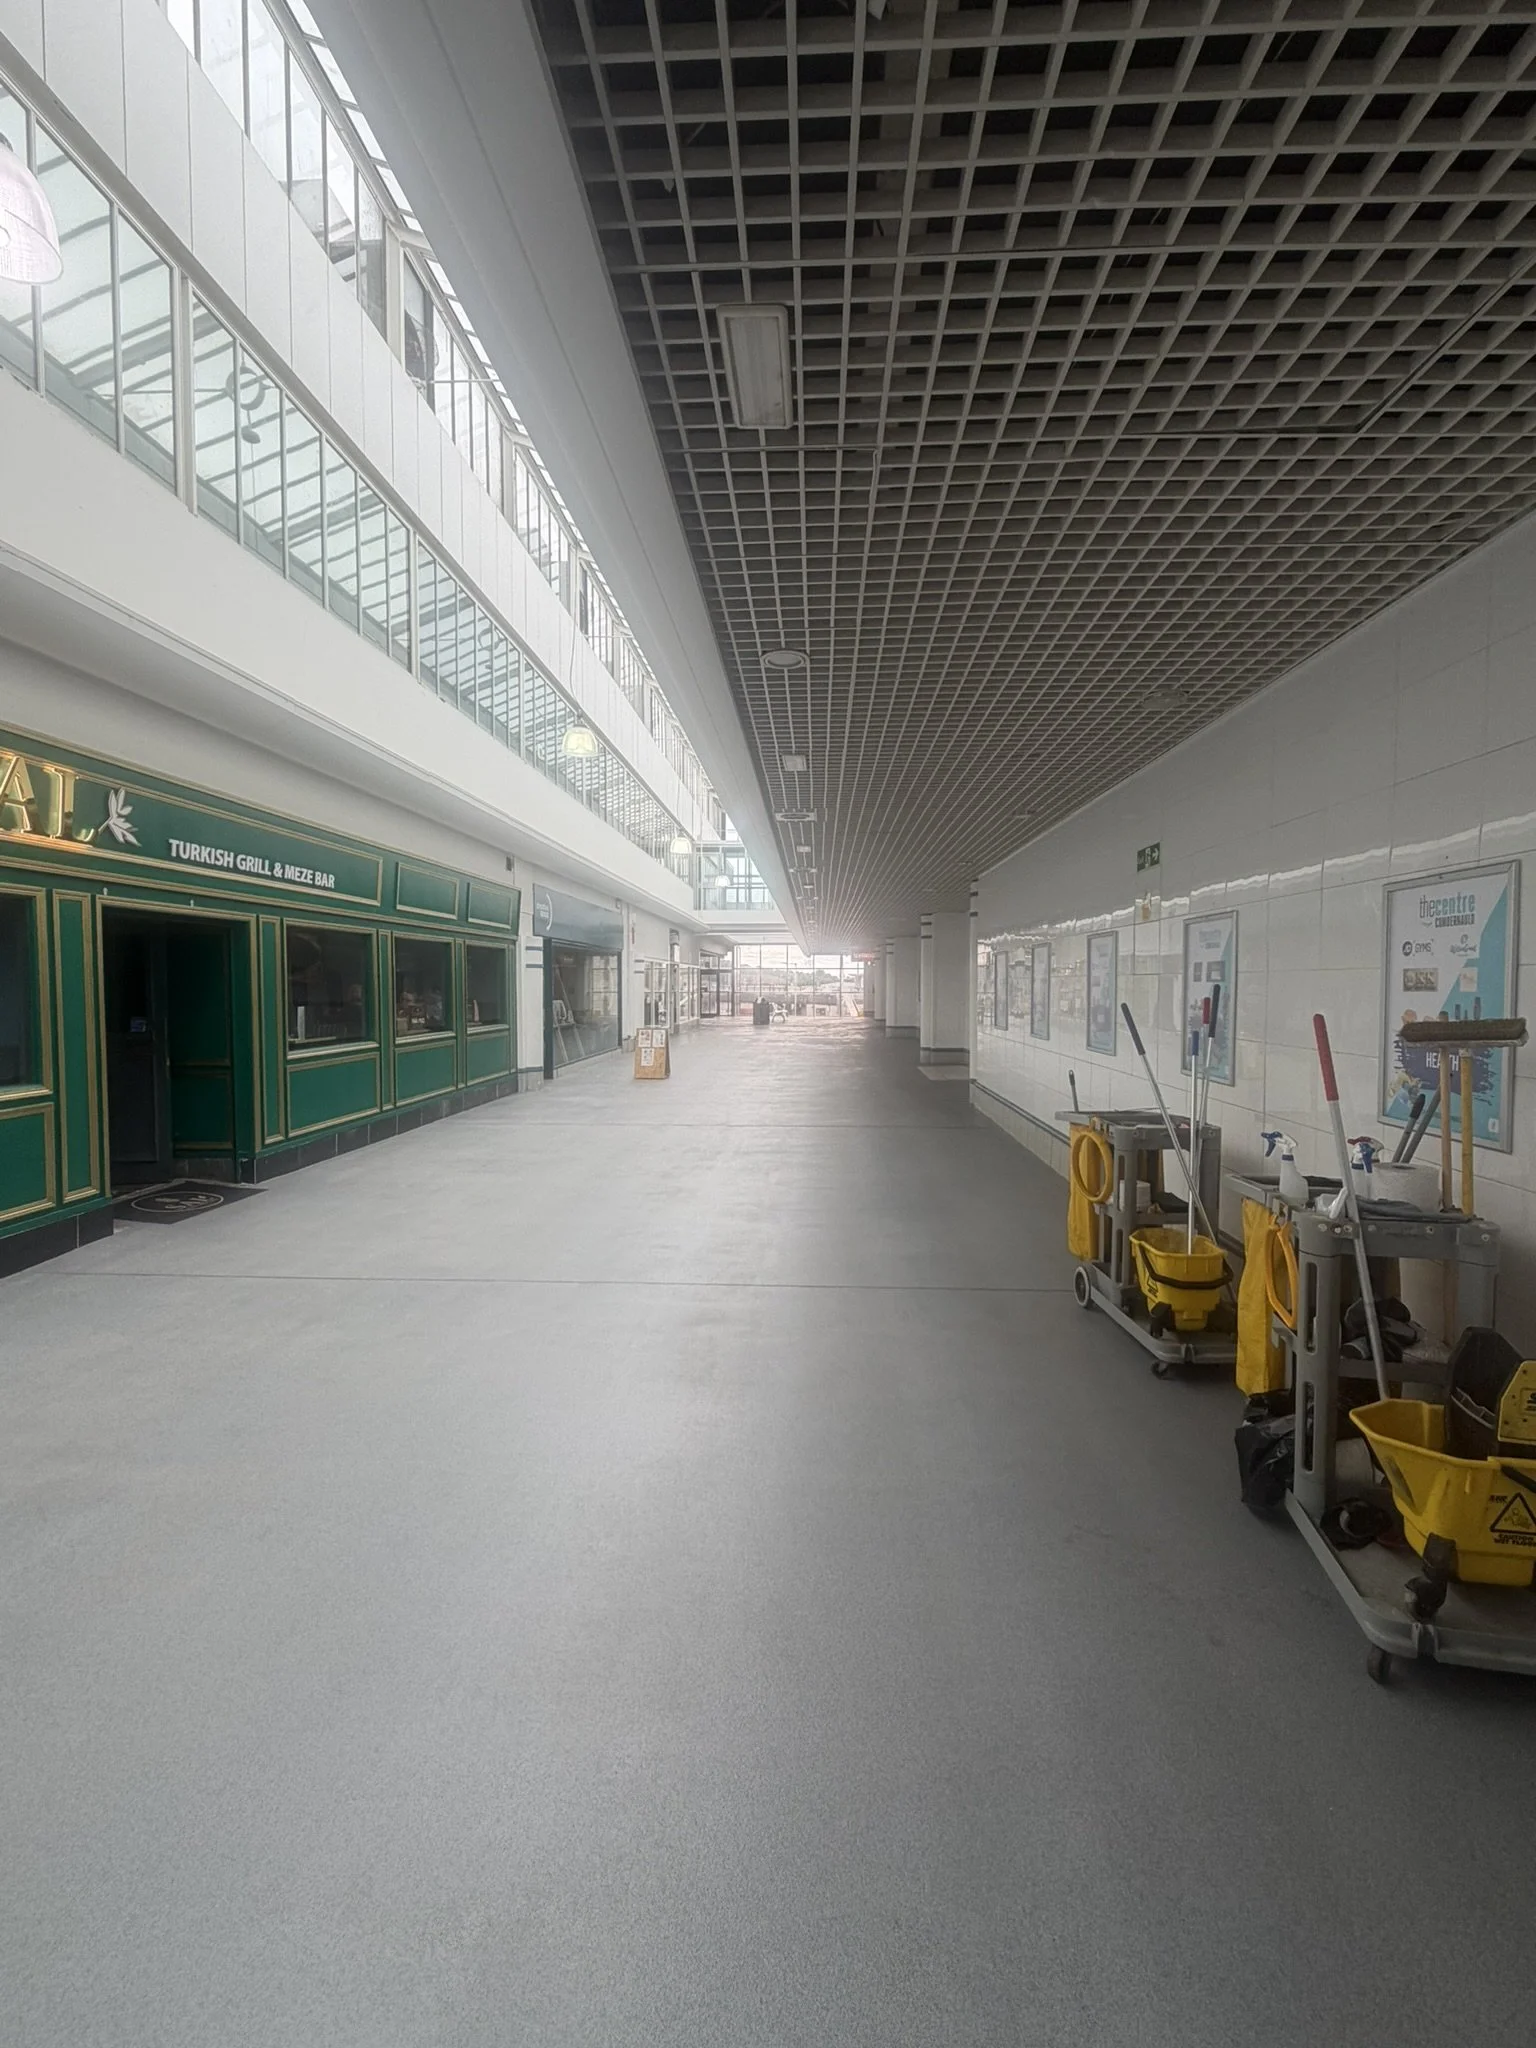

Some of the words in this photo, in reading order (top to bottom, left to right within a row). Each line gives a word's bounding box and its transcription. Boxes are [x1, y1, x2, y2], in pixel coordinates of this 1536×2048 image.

[168, 838, 234, 868] TURKISH
[236, 854, 271, 876] GRILL
[273, 862, 283, 878] &
[284, 865, 313, 884] MEZE
[314, 870, 336, 889] BAR
[1414, 942, 1431, 953] GYMS
[1425, 1051, 1459, 1072] HEATH
